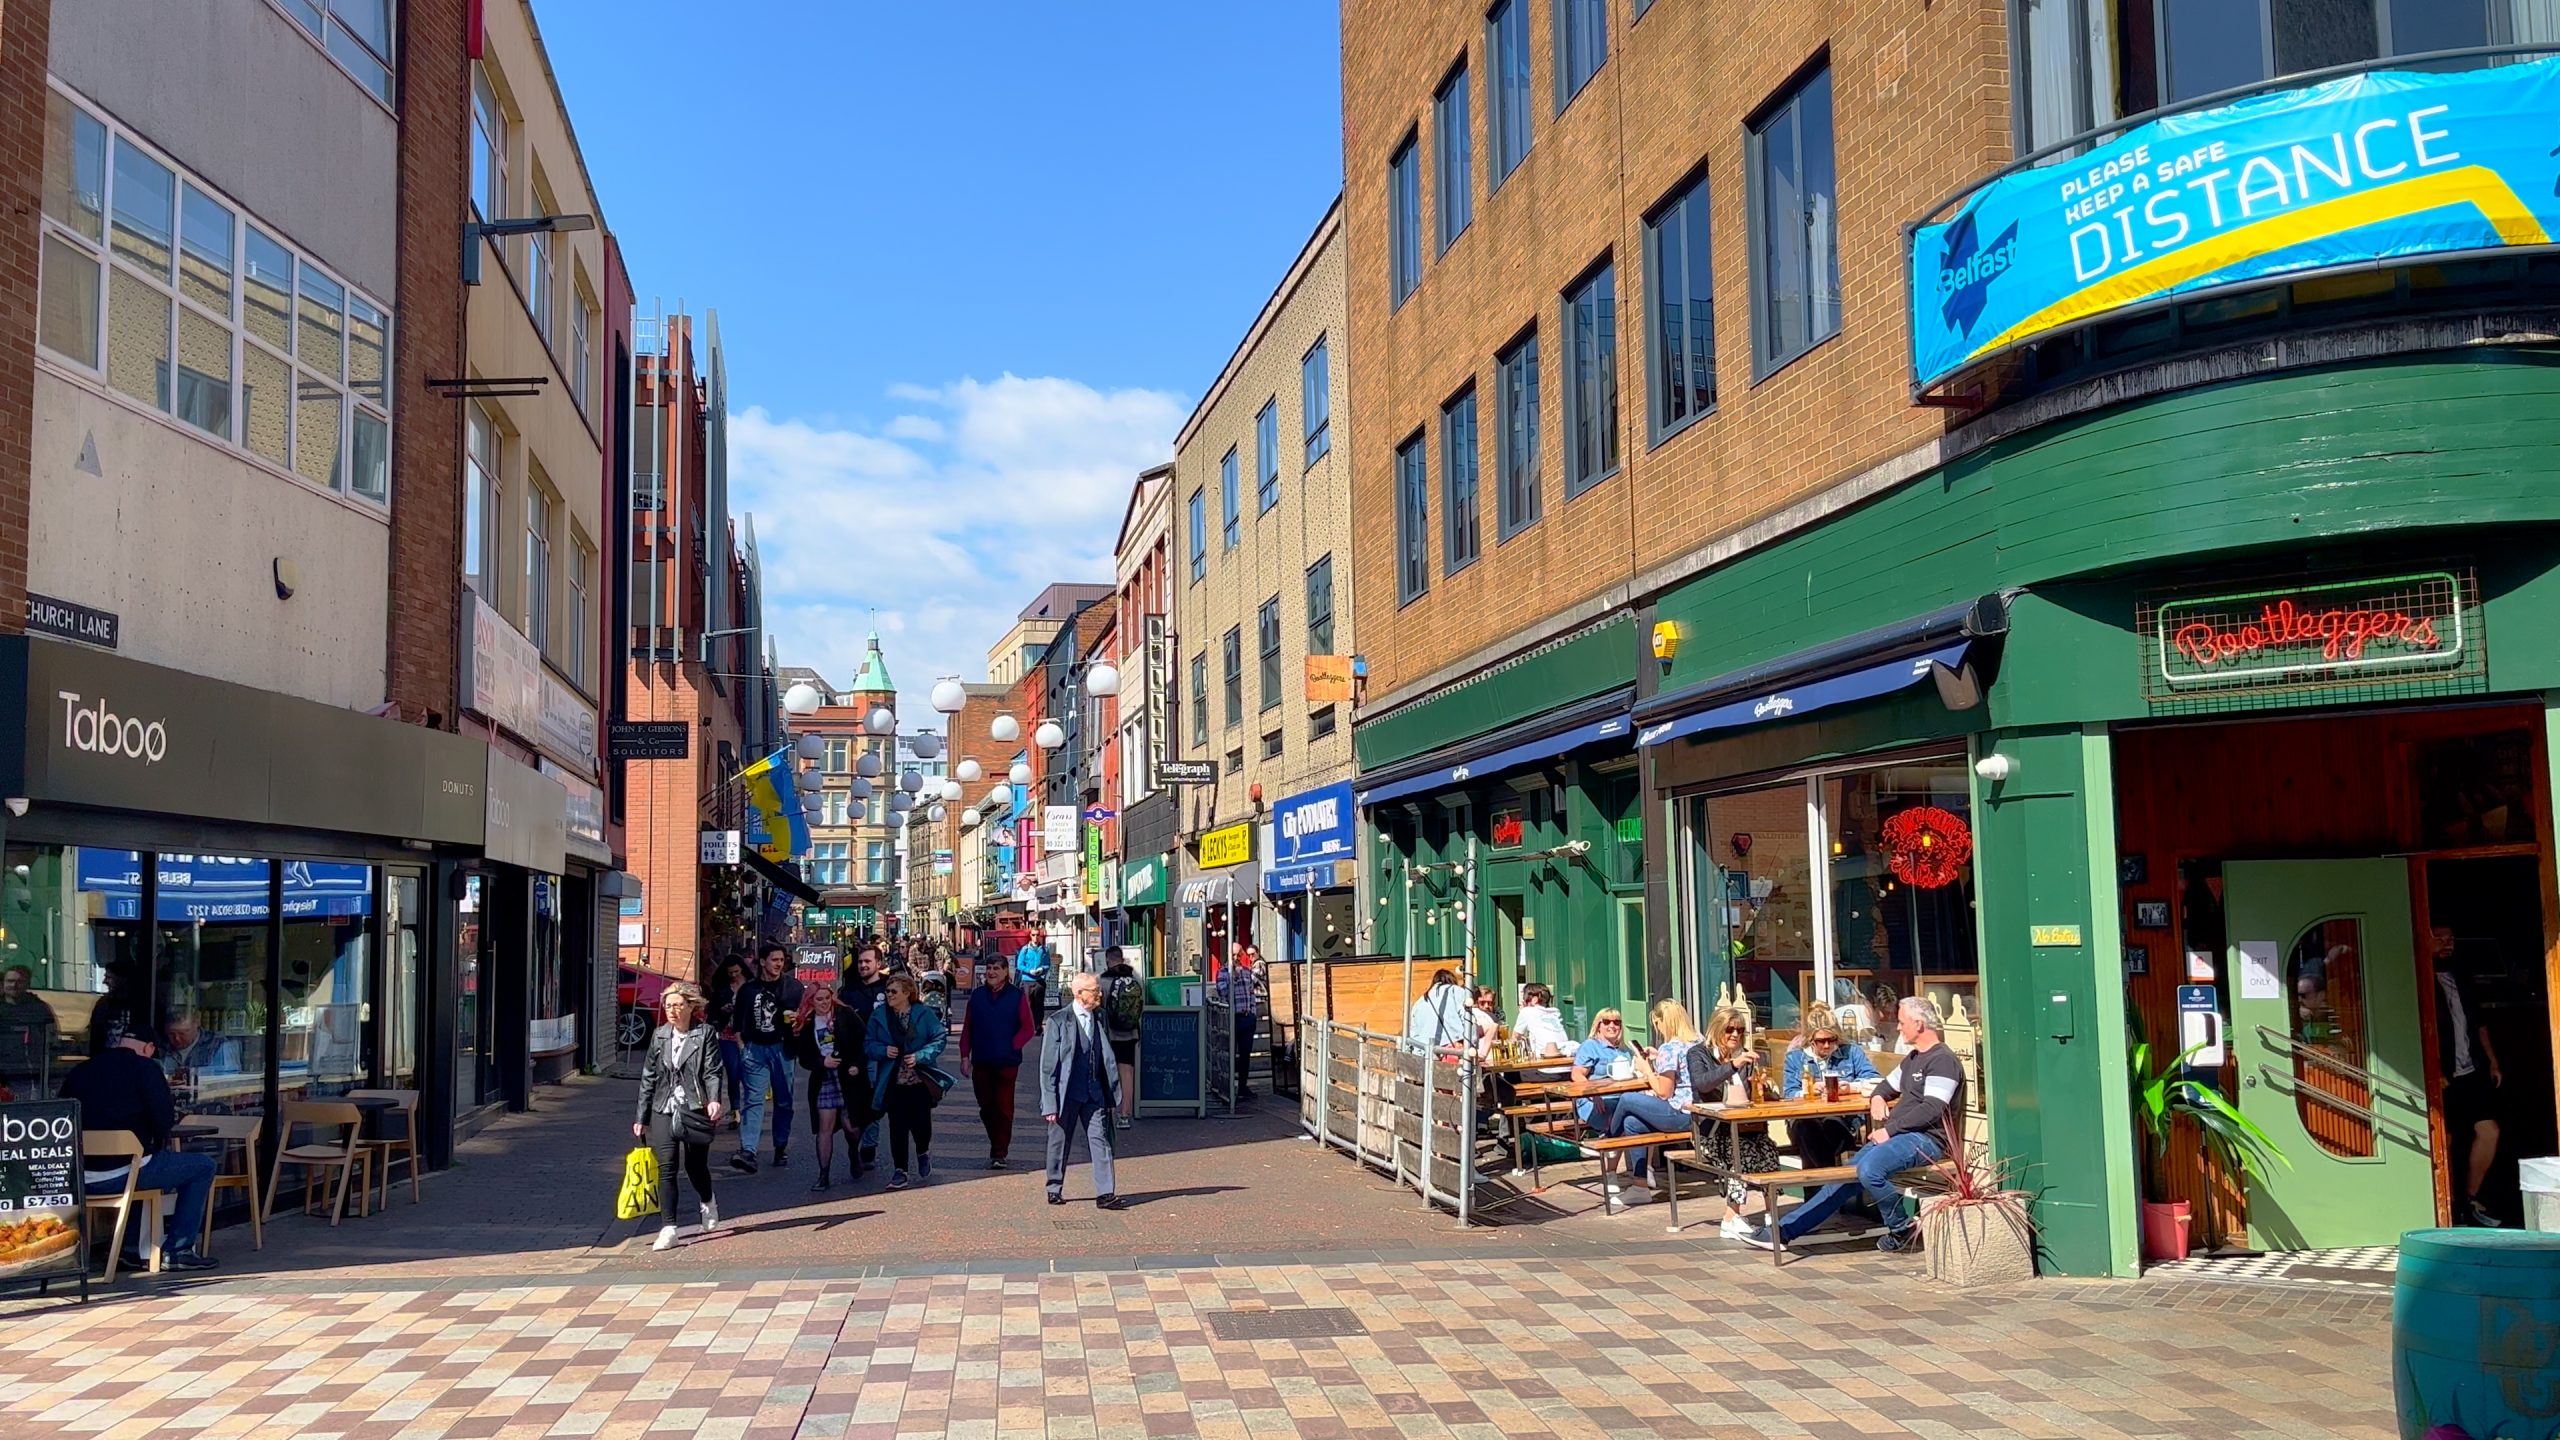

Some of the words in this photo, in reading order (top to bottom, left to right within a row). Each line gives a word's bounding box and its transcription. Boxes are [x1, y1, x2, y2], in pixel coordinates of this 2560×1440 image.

[2061, 145, 2151, 198] PLEASE
[2065, 189, 2126, 225] KEEP
[2132, 172, 2151, 194] A
[2157, 141, 2228, 183] SAFE
[2069, 104, 2462, 283] DISTANCE
[1939, 236, 2018, 294] Belfast
[25, 600, 74, 631] CHURCH
[79, 613, 111, 639] LANE
[2176, 600, 2440, 664] Bootleggers
[612, 725, 635, 734] JOHN
[648, 725, 687, 733] GIBBONS
[1161, 763, 1210, 776] Telegraph
[442, 780, 474, 796] DONUTS
[1090, 826, 1098, 890] GEORGES
[2034, 927, 2049, 943] No
[2051, 927, 2080, 945] Entry
[823, 950, 836, 966] Fry
[2251, 957, 2268, 966] EXIT
[2250, 977, 2271, 986] ONLY
[0, 1149, 27, 1161] EAL
[31, 1146, 73, 1159] DEALS
[28, 1196, 69, 1206] £7.50
